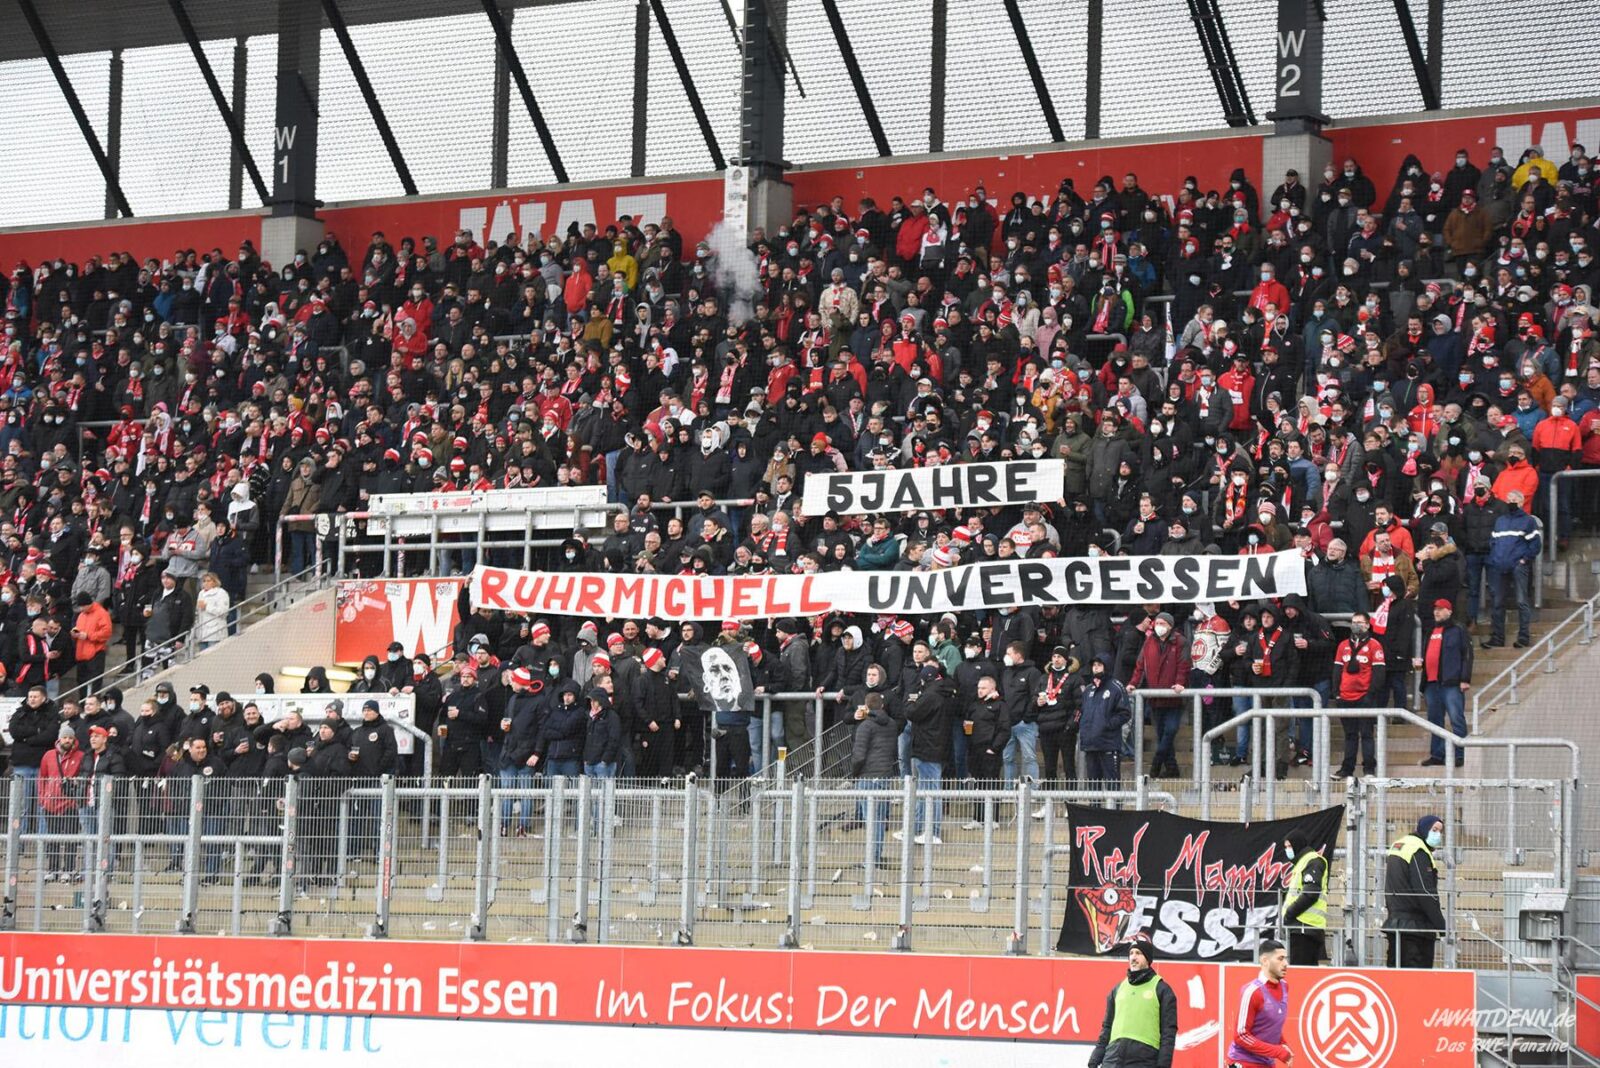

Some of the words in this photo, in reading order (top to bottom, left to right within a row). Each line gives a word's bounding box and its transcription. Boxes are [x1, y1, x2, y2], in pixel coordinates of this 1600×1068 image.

[1278, 29, 1306, 58] W
[1280, 64, 1301, 97] 2
[275, 125, 297, 151] W
[278, 155, 288, 184] 1
[481, 569, 832, 617] RUHRMICHELL
[868, 555, 1279, 611] UNVERGESSEN
[1076, 822, 1149, 900] Red
[0, 955, 421, 1012] Universitätsmedizin
[438, 968, 558, 1017] Essen
[595, 979, 648, 1019] Im
[667, 977, 794, 1025] Fokus:
[816, 985, 896, 1029] Der
[914, 987, 1080, 1035] Mensch
